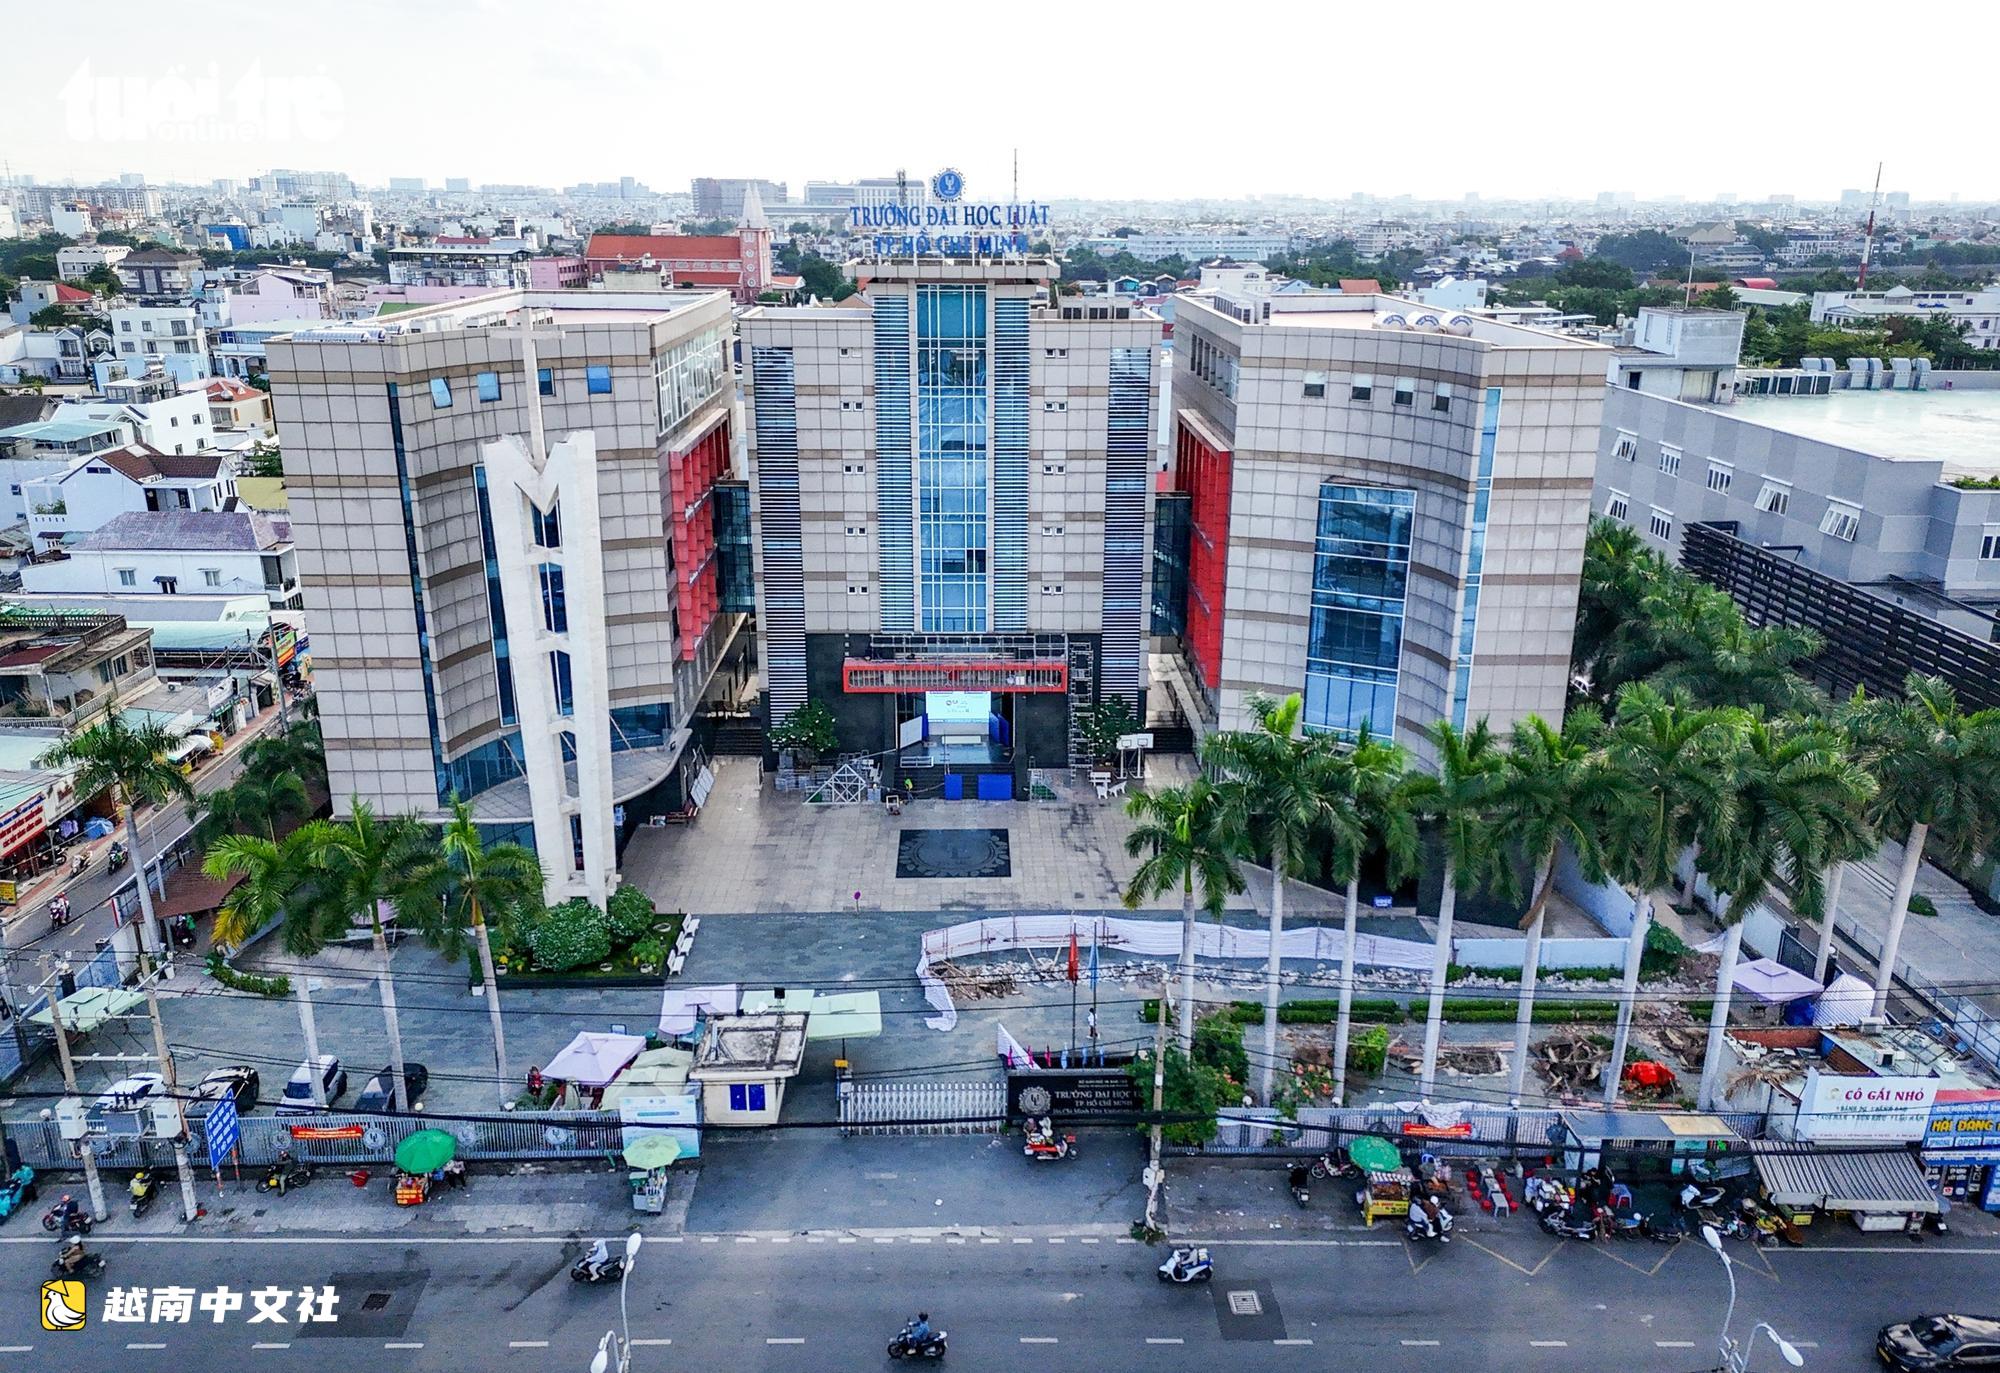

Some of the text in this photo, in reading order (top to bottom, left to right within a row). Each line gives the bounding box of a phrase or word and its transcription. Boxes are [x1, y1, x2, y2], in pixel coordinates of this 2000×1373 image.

[850, 200, 1050, 229] TRƯỜNG ĐẠI HỌC LUẬT
[1055, 1089, 1092, 1099] TRƯỜNG
[1844, 1087, 1924, 1101] CÔ GÁI NHỎ
